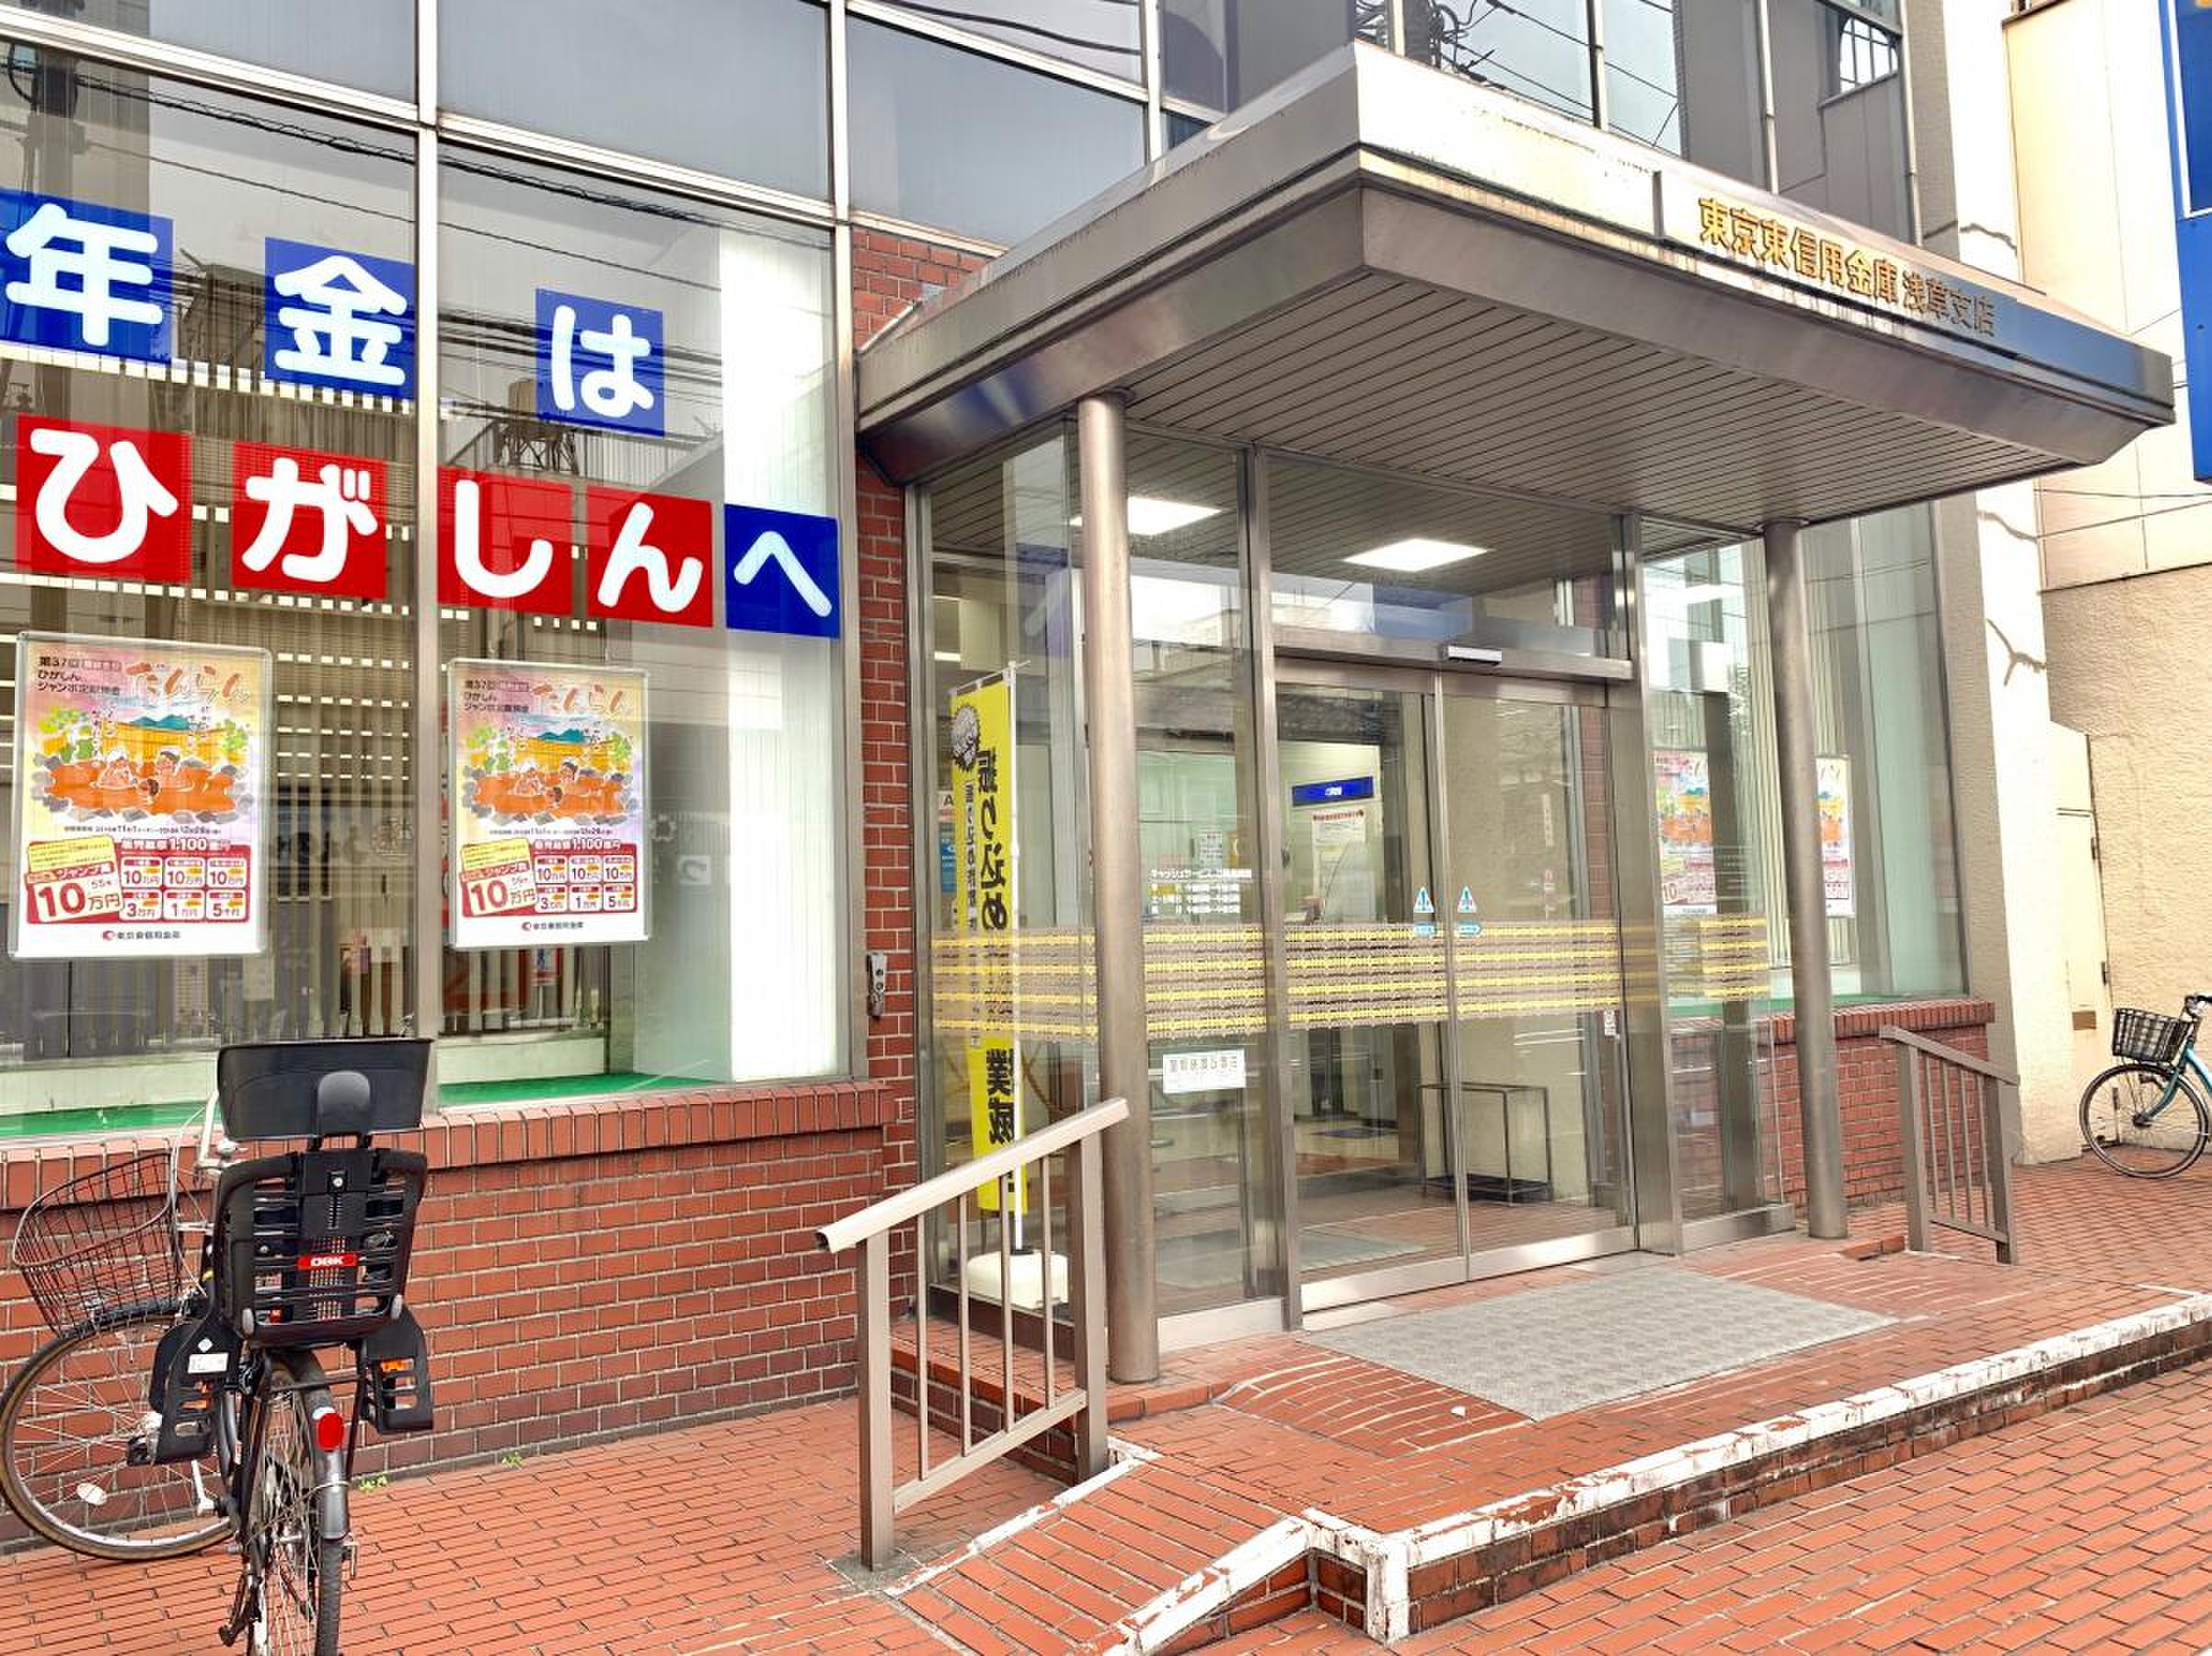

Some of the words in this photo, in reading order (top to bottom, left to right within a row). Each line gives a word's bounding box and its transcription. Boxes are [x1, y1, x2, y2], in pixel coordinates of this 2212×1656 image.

[1699, 196, 1995, 337] 東京東信用金庫浅草支店
[29, 426, 833, 617] ひがしんへ
[38, 880, 121, 918] 10万円
